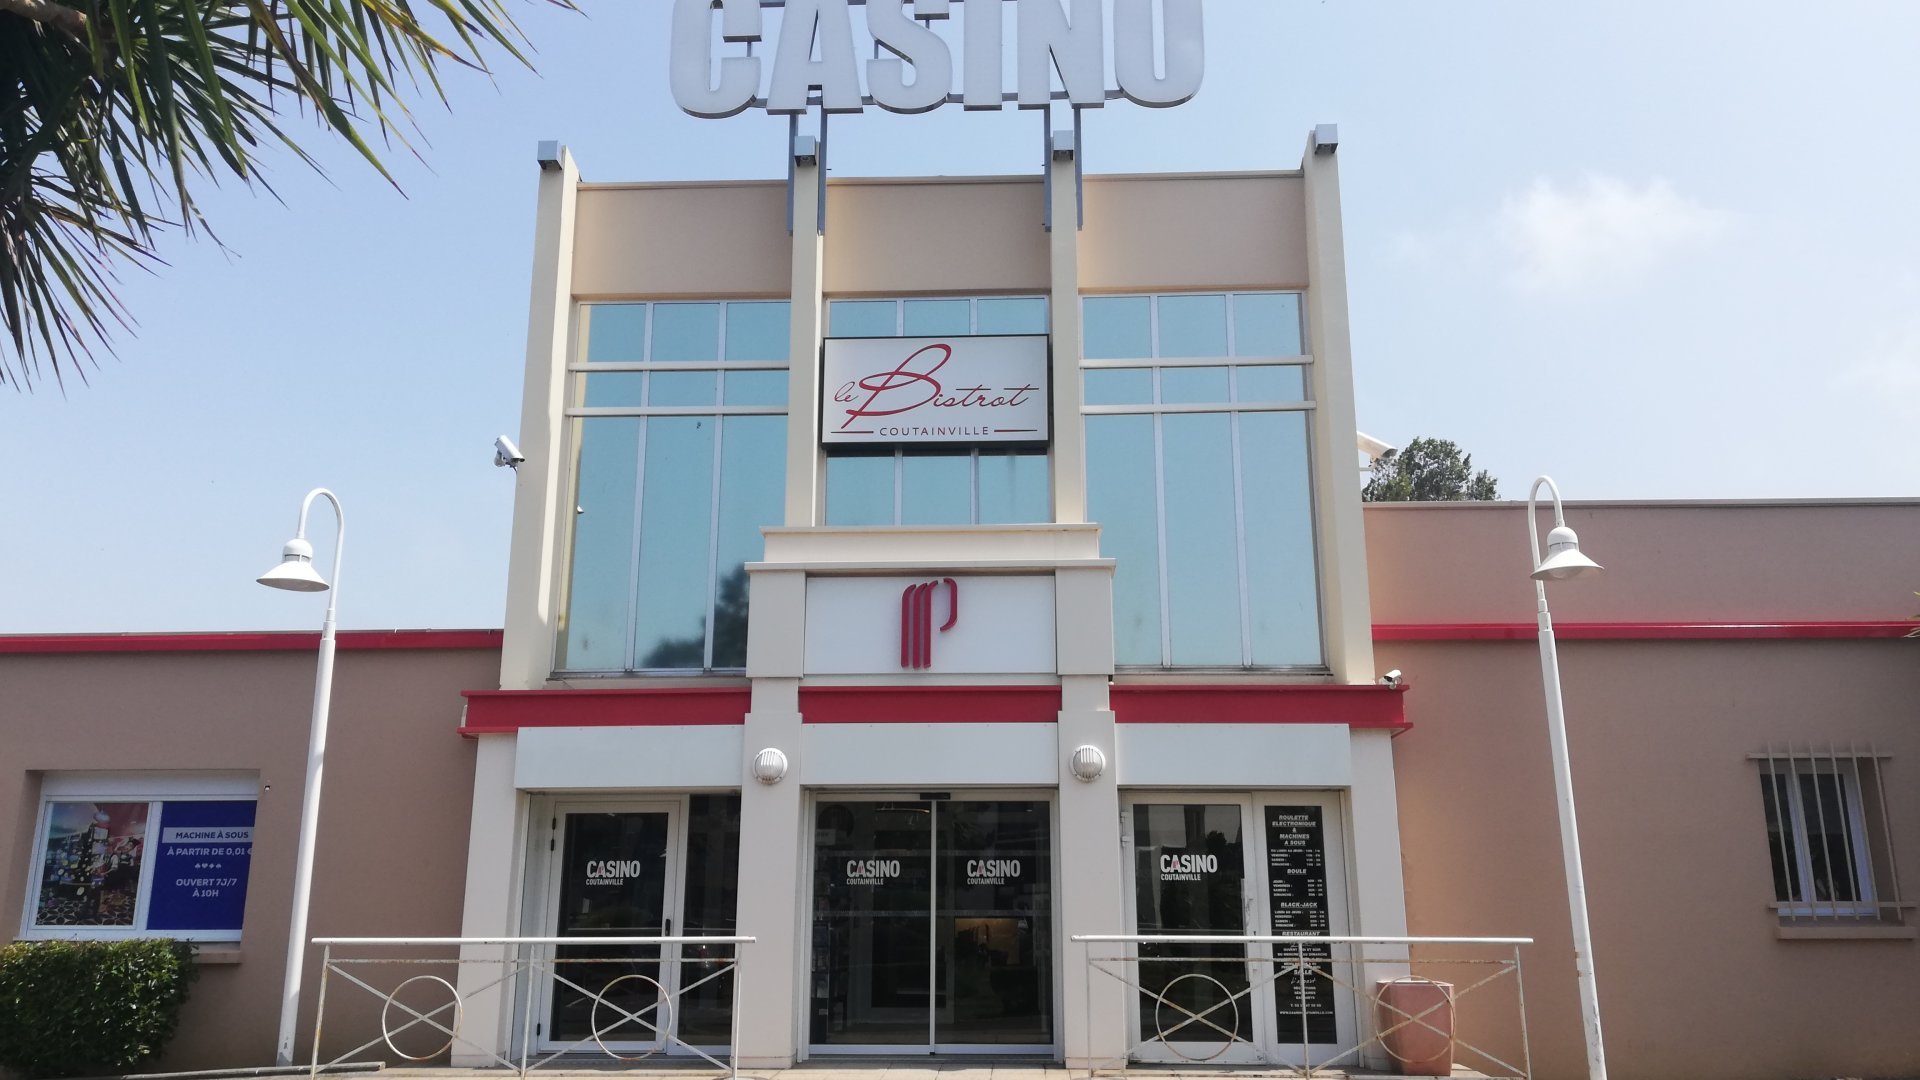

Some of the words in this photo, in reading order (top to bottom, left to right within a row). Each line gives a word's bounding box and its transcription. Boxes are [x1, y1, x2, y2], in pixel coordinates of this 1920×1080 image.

[669, 0, 1204, 118] CASINO
[833, 381, 858, 402] le
[841, 343, 1039, 429] Bistrot
[879, 426, 989, 436] COUTAINVILLE
[217, 830, 224, 839] À
[166, 846, 174, 856] À
[226, 848, 244, 856] 0,01
[586, 860, 640, 878] CASINO
[846, 860, 900, 878] CASINO
[967, 860, 1020, 877] CASINO
[1160, 854, 1218, 873] CASINO
[216, 878, 237, 886] 7J/7
[192, 888, 200, 897] À
